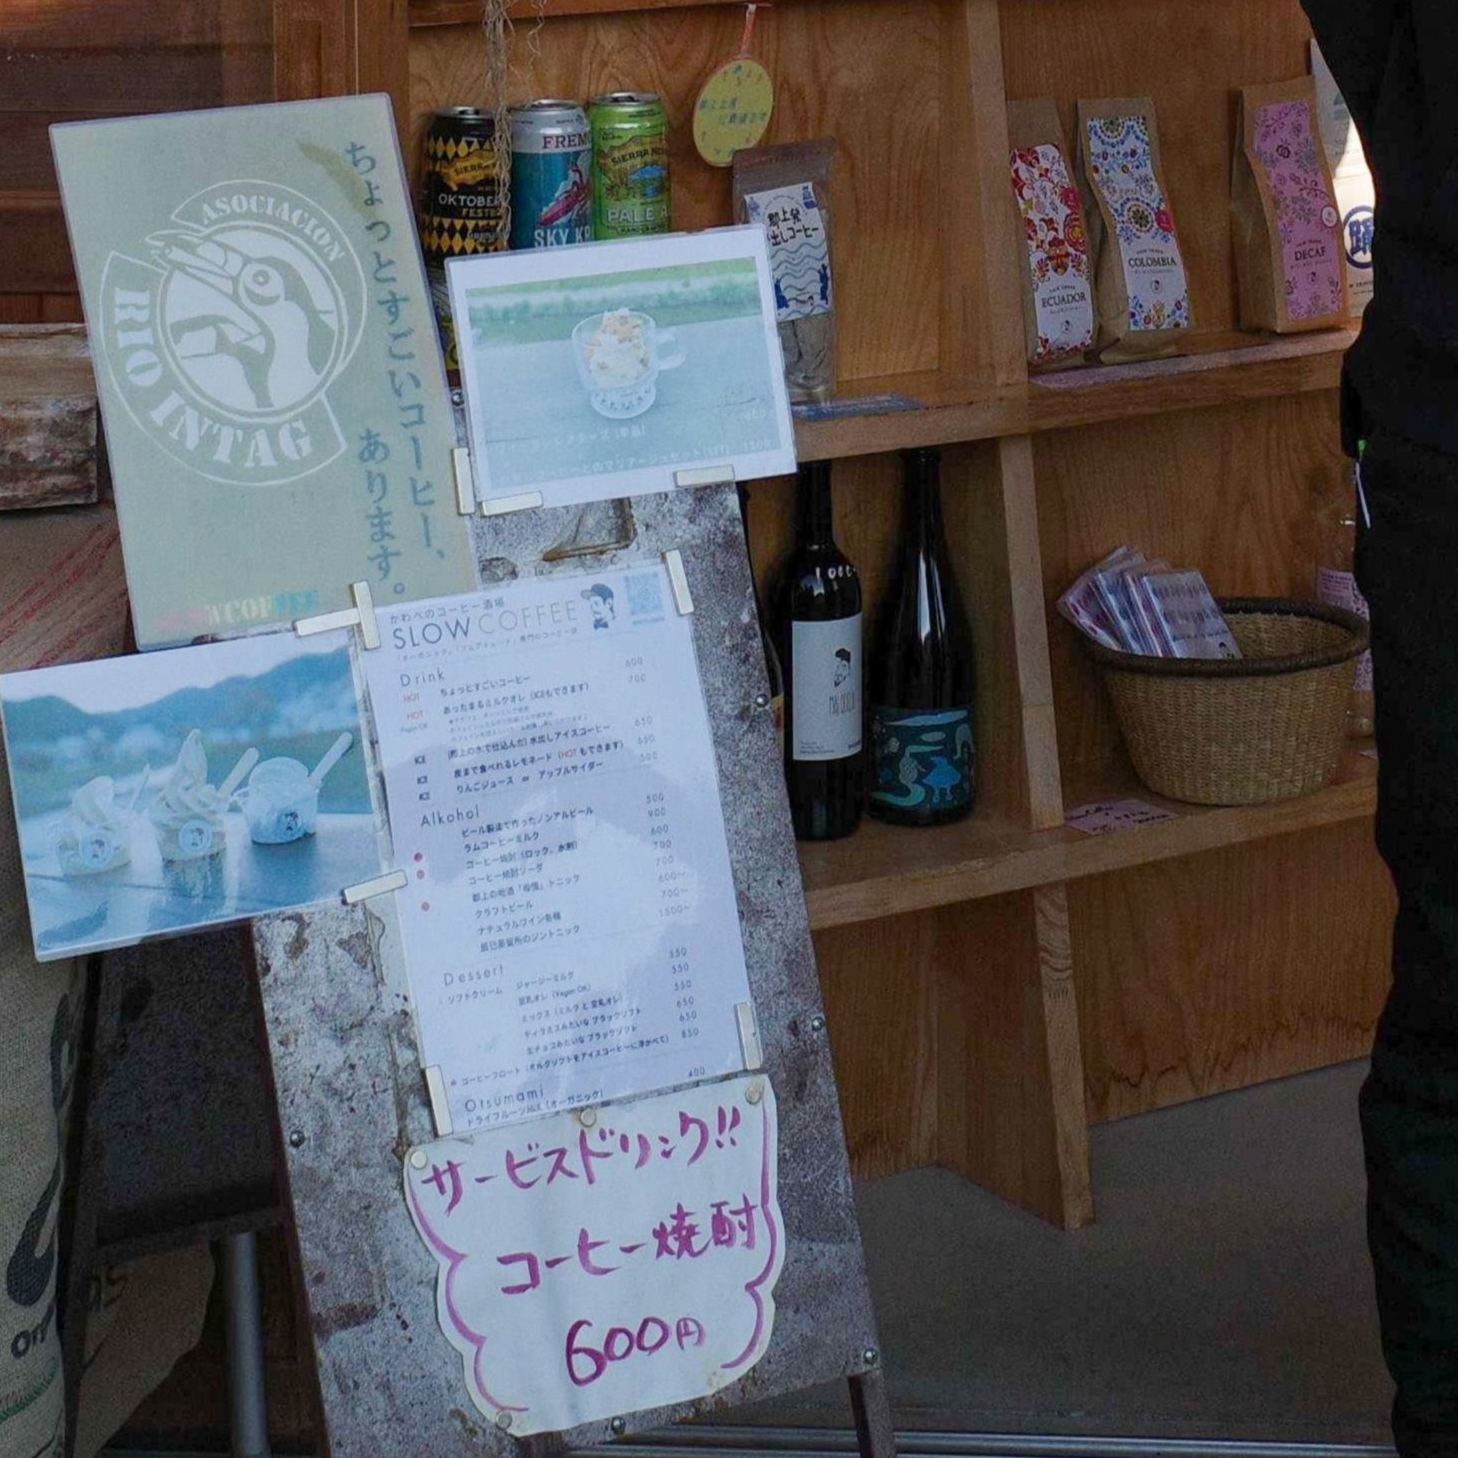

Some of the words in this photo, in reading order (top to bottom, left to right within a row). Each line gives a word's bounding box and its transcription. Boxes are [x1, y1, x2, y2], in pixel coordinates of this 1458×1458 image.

[607, 206, 656, 224] PALE
[201, 193, 348, 264] ASOCIACION
[533, 226, 569, 251] SKY
[1127, 254, 1179, 270] COLOMBIA
[1293, 245, 1327, 262] DECAF
[1041, 291, 1088, 310] ECUADOR
[114, 286, 165, 387] RIO
[149, 394, 315, 469] INTAG
[392, 619, 471, 651] SLOW
[478, 599, 580, 636] COFFEE
[400, 668, 446, 689] Drink
[440, 674, 532, 698] ちょっとすごいコーヒー
[421, 803, 481, 828] Alkohol
[475, 900, 534, 920] クラフトビール
[443, 964, 505, 988] Dessert
[464, 1087, 545, 1115] Otsumami
[421, 1105, 742, 1218] サービスドリンク!!
[495, 1193, 759, 1296] コーヒー焼酎
[564, 1315, 708, 1388] 600円
